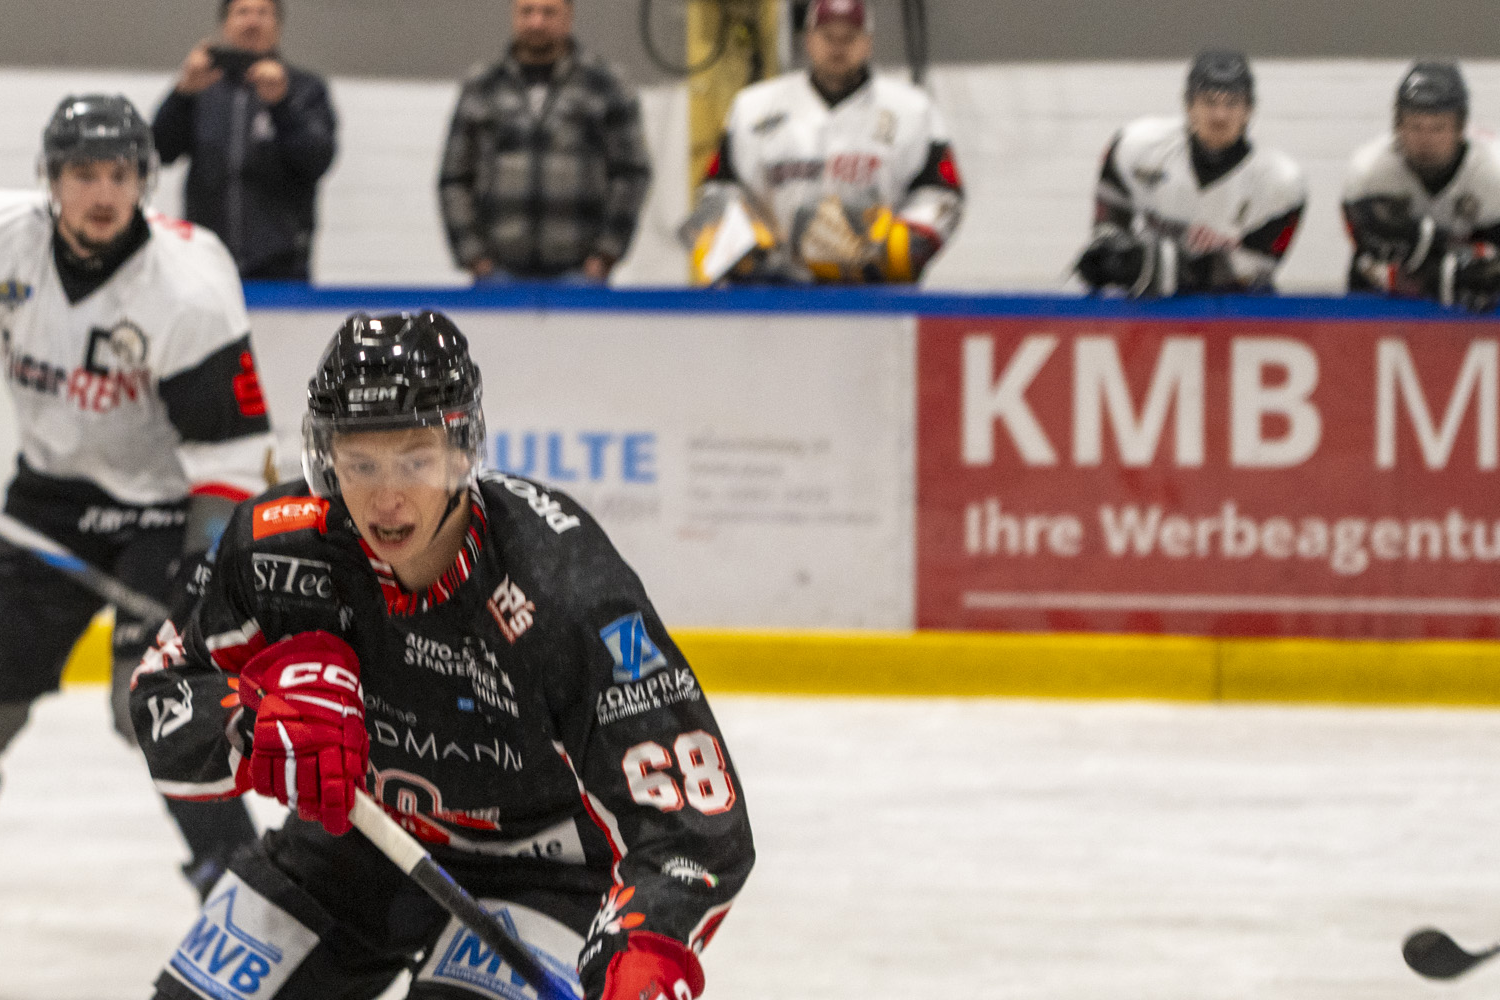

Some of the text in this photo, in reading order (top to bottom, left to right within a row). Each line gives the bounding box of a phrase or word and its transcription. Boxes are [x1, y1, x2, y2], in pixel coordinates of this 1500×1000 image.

[961, 333, 1323, 468] KMB
[966, 500, 1084, 557] Ihre
[367, 719, 523, 772] DMANN
[621, 729, 737, 816] 68
[181, 915, 271, 995] MVB
